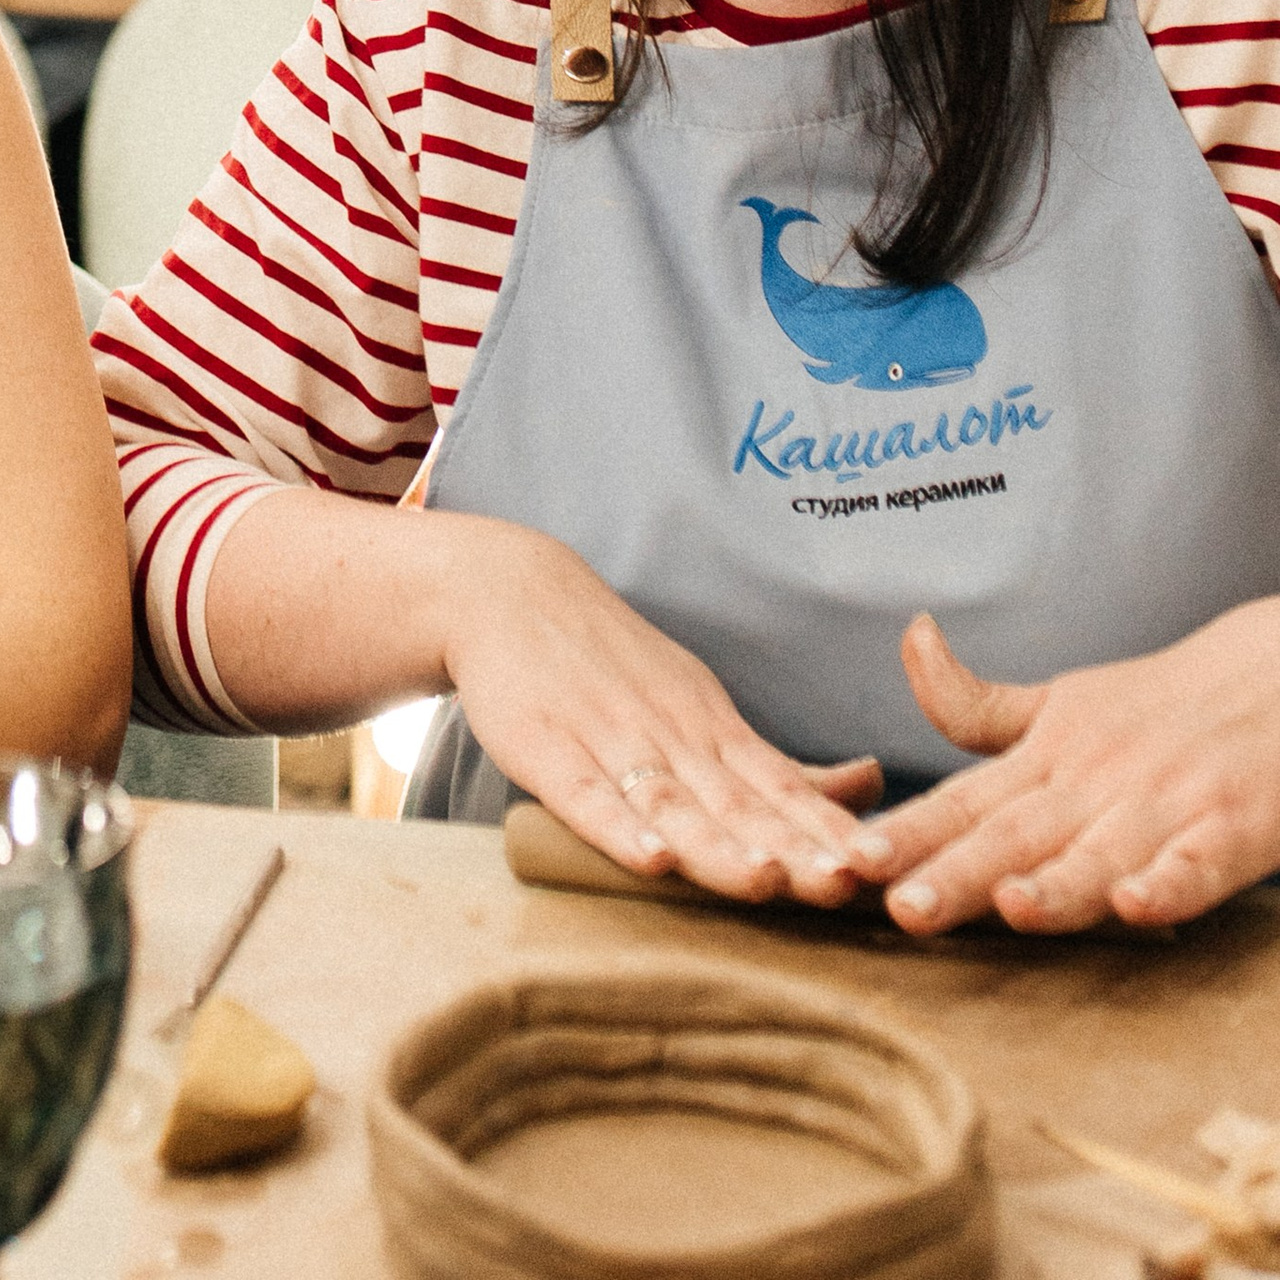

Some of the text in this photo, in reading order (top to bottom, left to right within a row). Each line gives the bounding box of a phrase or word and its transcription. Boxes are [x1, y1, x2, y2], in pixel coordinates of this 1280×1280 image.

[732, 384, 1054, 484] Кашалот
[791, 472, 1008, 520] студия керамики
